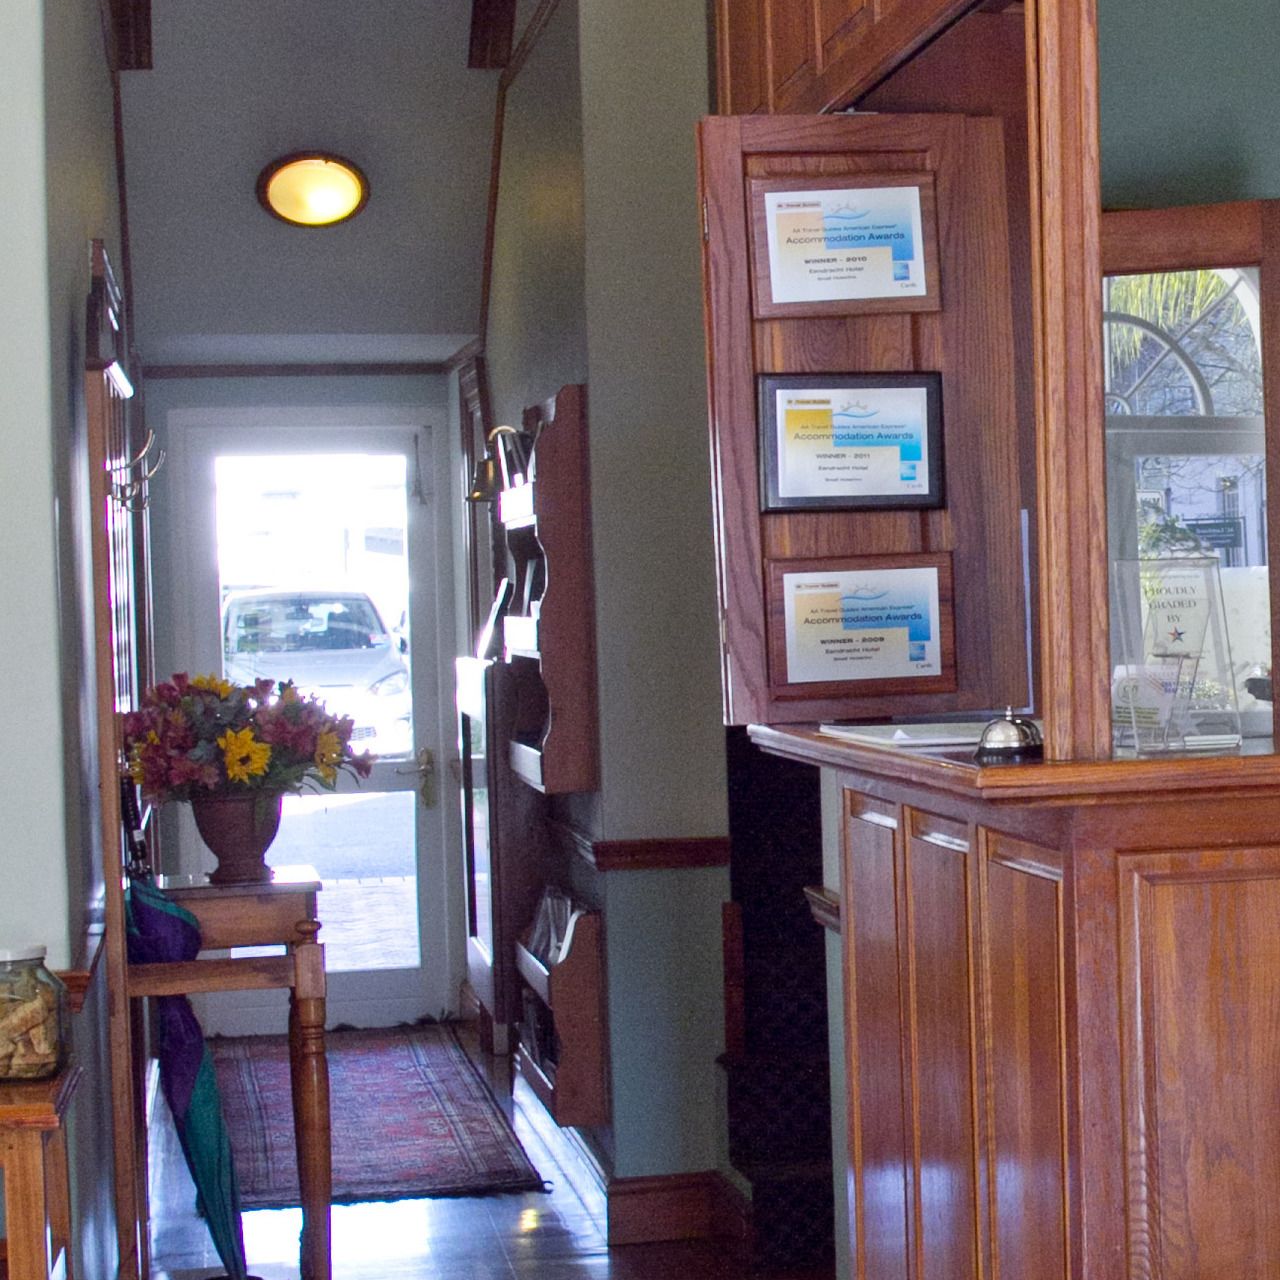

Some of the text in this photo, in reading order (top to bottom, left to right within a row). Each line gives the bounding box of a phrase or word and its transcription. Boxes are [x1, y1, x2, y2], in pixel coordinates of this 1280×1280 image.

[786, 231, 905, 245] Accommodation Awards
[793, 431, 914, 441] Accommodation Awards
[1144, 585, 1197, 595] PROUDLY
[1149, 600, 1197, 609] GRADED
[803, 612, 922, 625] Accommodation Awards
[1167, 614, 1182, 623] BY
